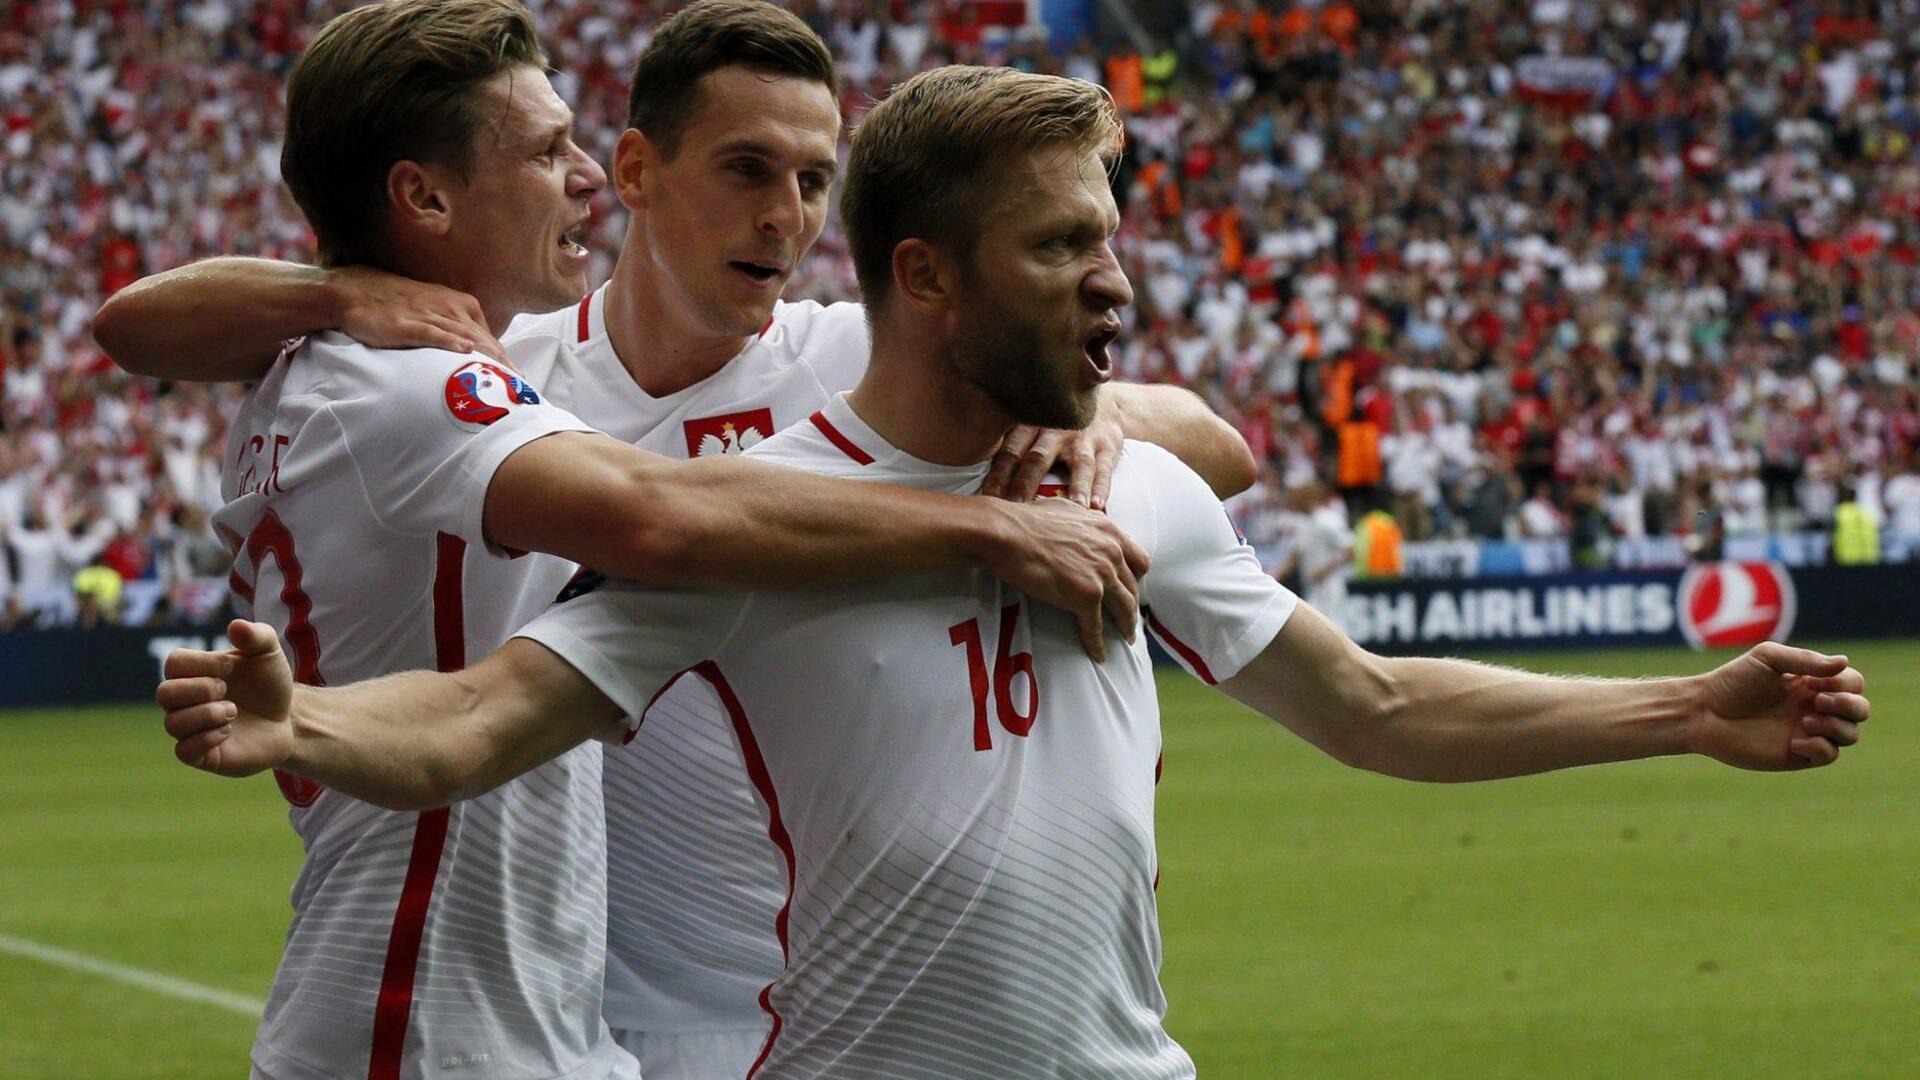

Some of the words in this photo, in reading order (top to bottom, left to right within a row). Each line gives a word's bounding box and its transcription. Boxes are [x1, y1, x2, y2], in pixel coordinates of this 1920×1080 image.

[1345, 592, 1416, 643] SH
[1422, 583, 1675, 640] AIRLINES
[948, 602, 1040, 752] 16
